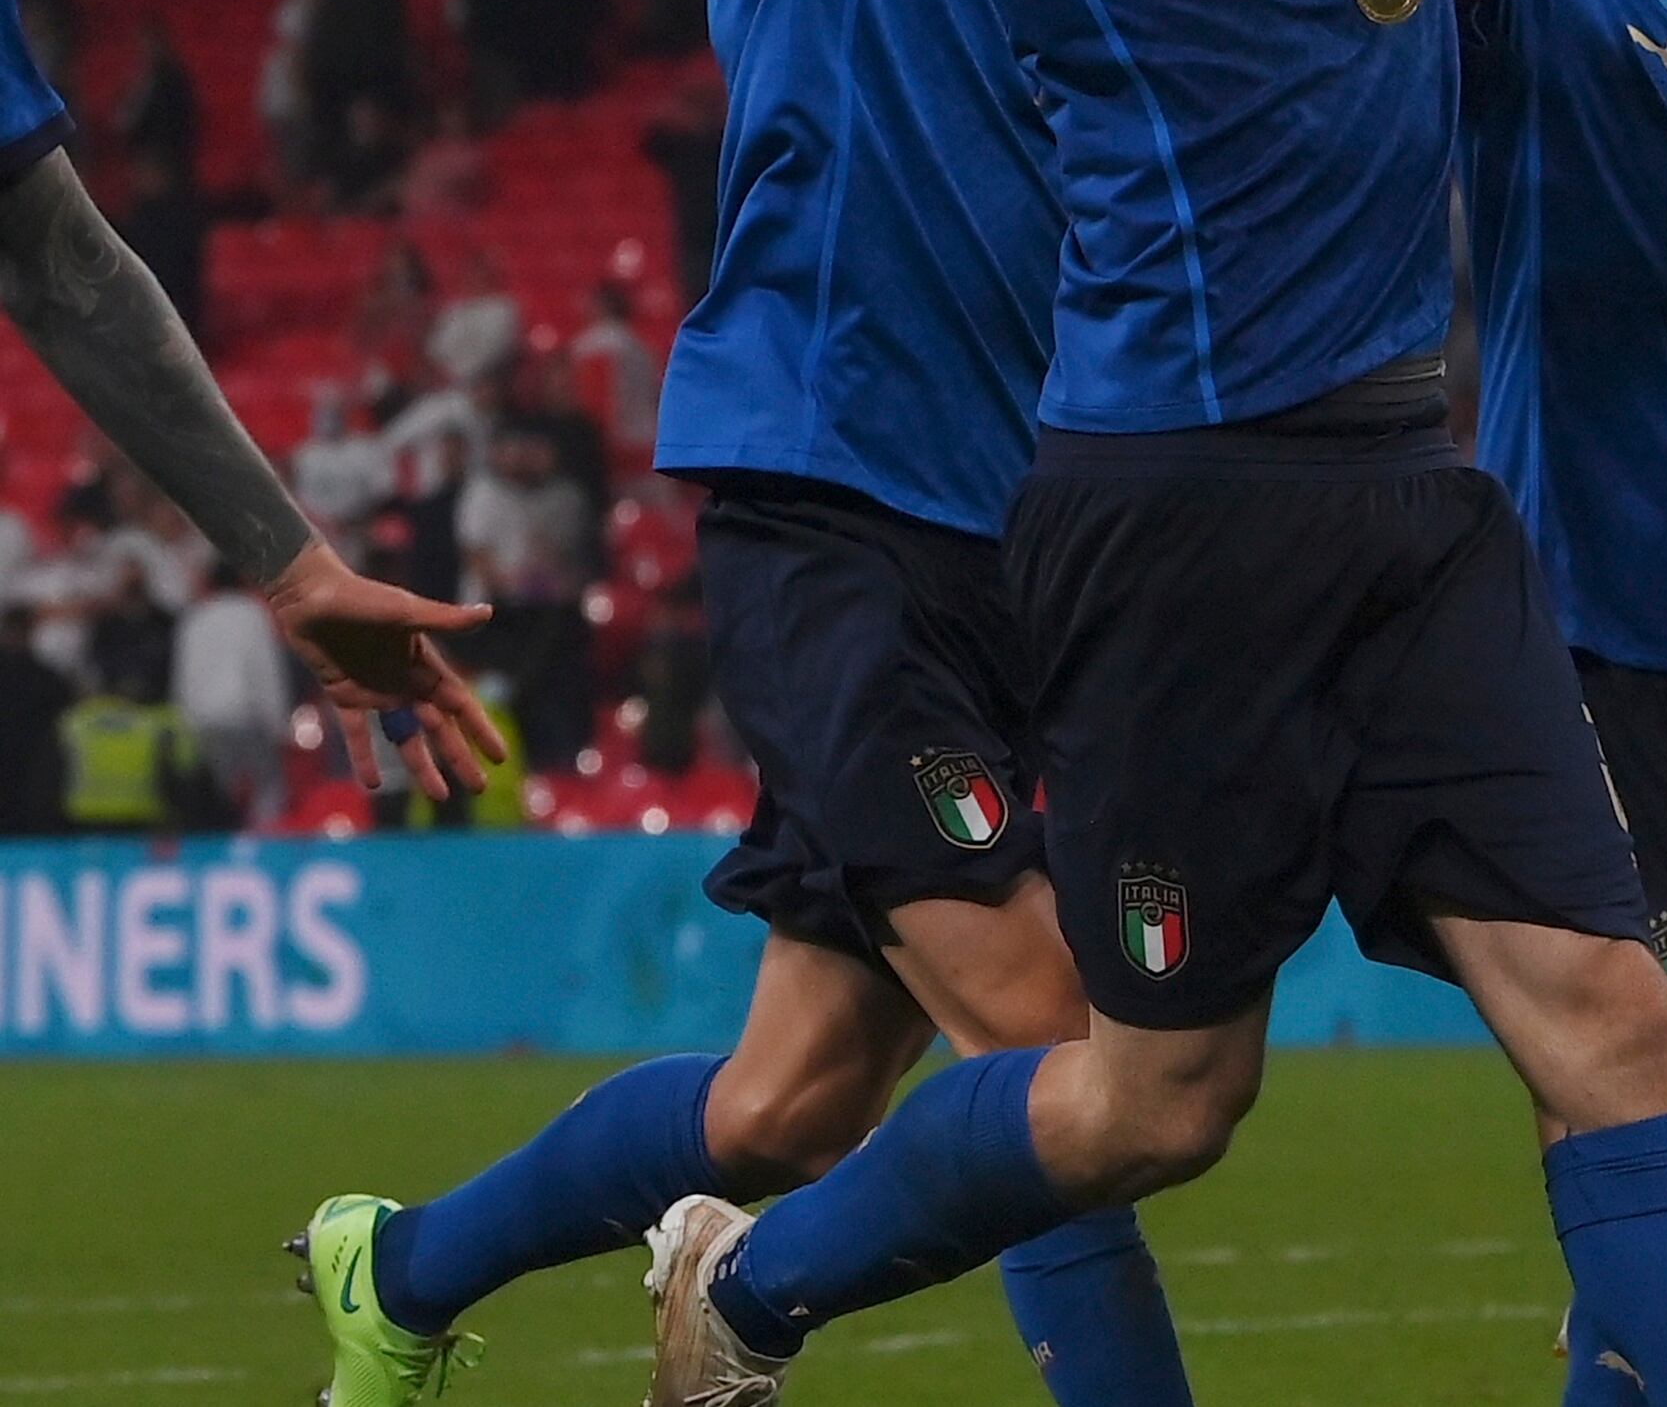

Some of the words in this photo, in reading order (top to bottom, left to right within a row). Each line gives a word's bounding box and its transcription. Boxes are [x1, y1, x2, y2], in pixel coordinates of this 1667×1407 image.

[923, 758, 981, 788] ITALIA
[1124, 885, 1181, 905] ITALIA
[0, 861, 367, 1035] NERS
